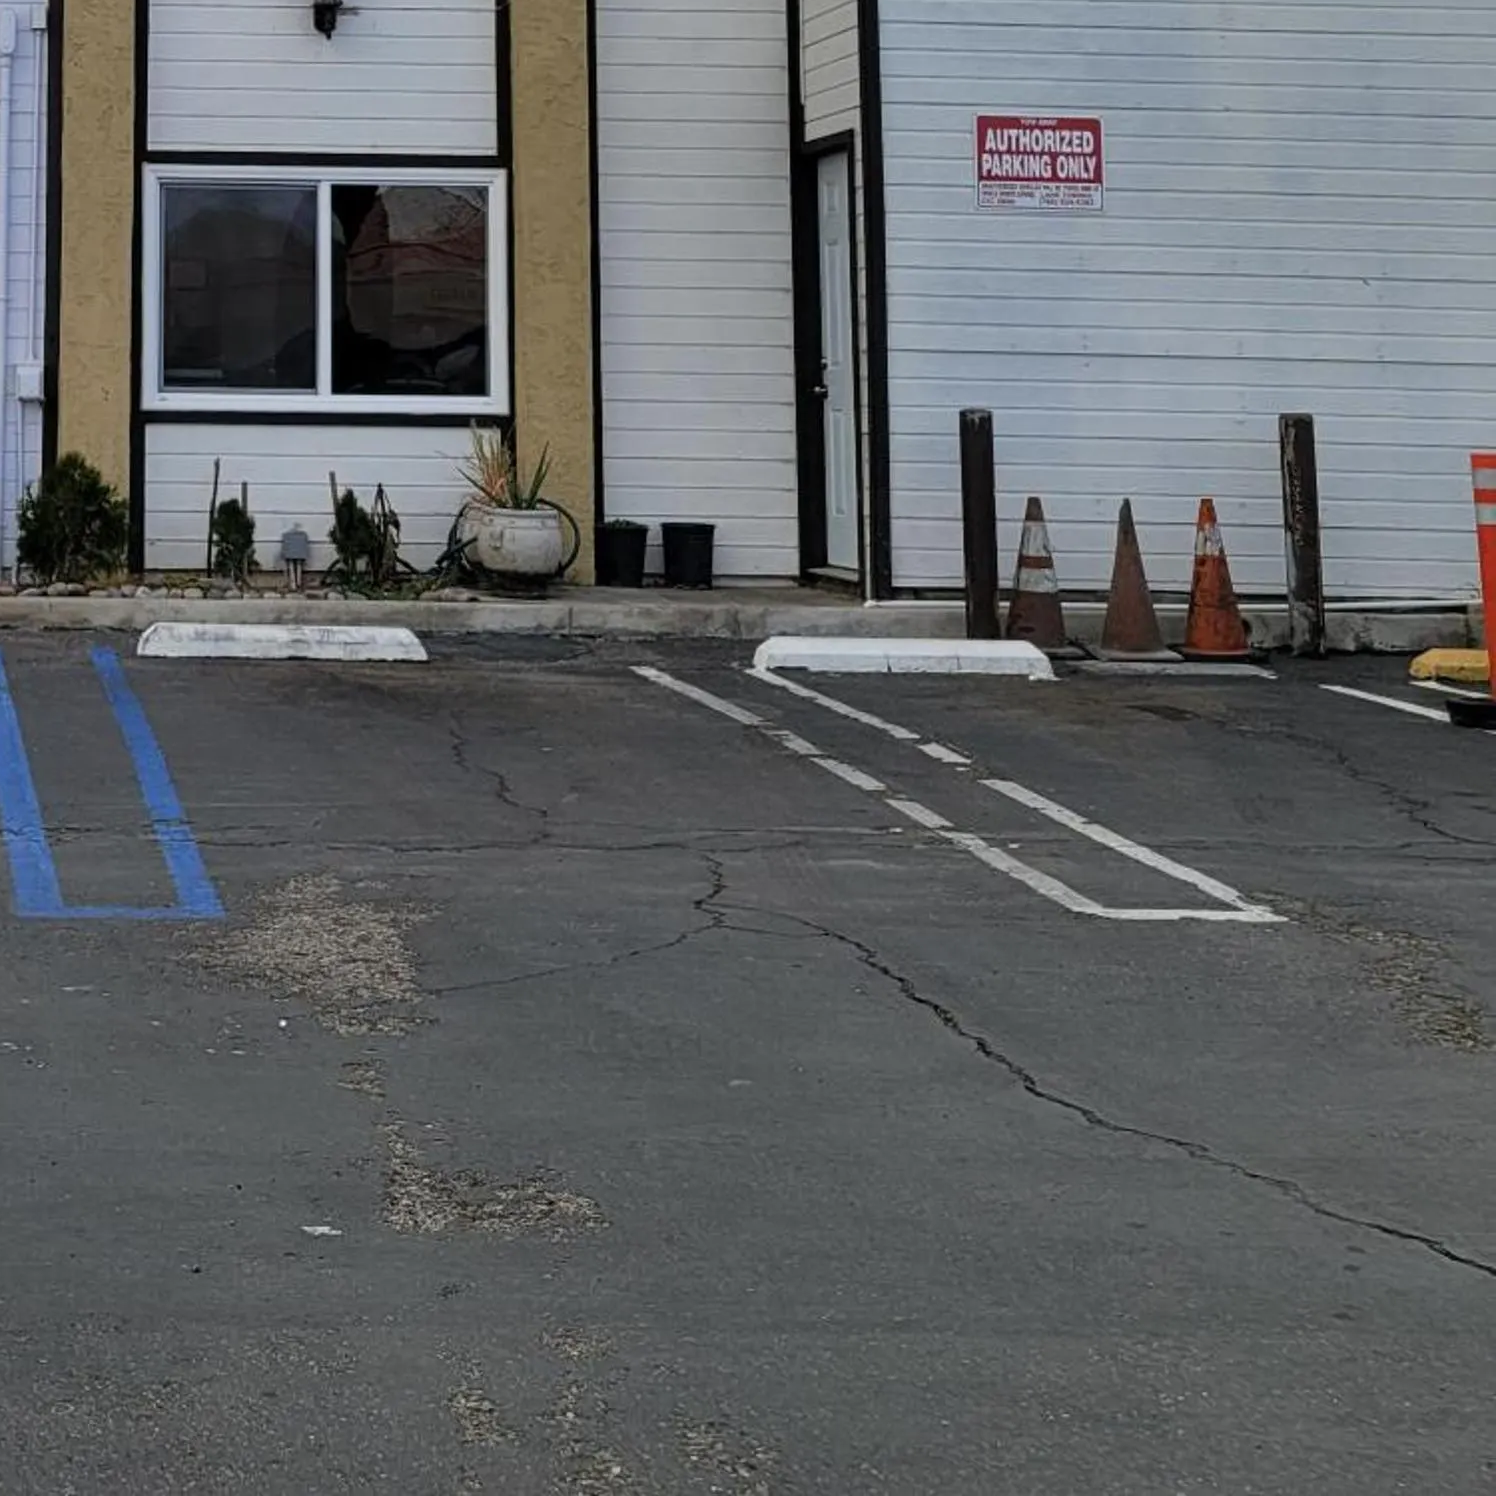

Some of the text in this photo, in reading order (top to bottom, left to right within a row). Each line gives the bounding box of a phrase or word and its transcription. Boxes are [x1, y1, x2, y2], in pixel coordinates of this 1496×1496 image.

[985, 128, 1094, 154] AUTHORIZED
[981, 153, 1097, 180] PARKING ONLY
